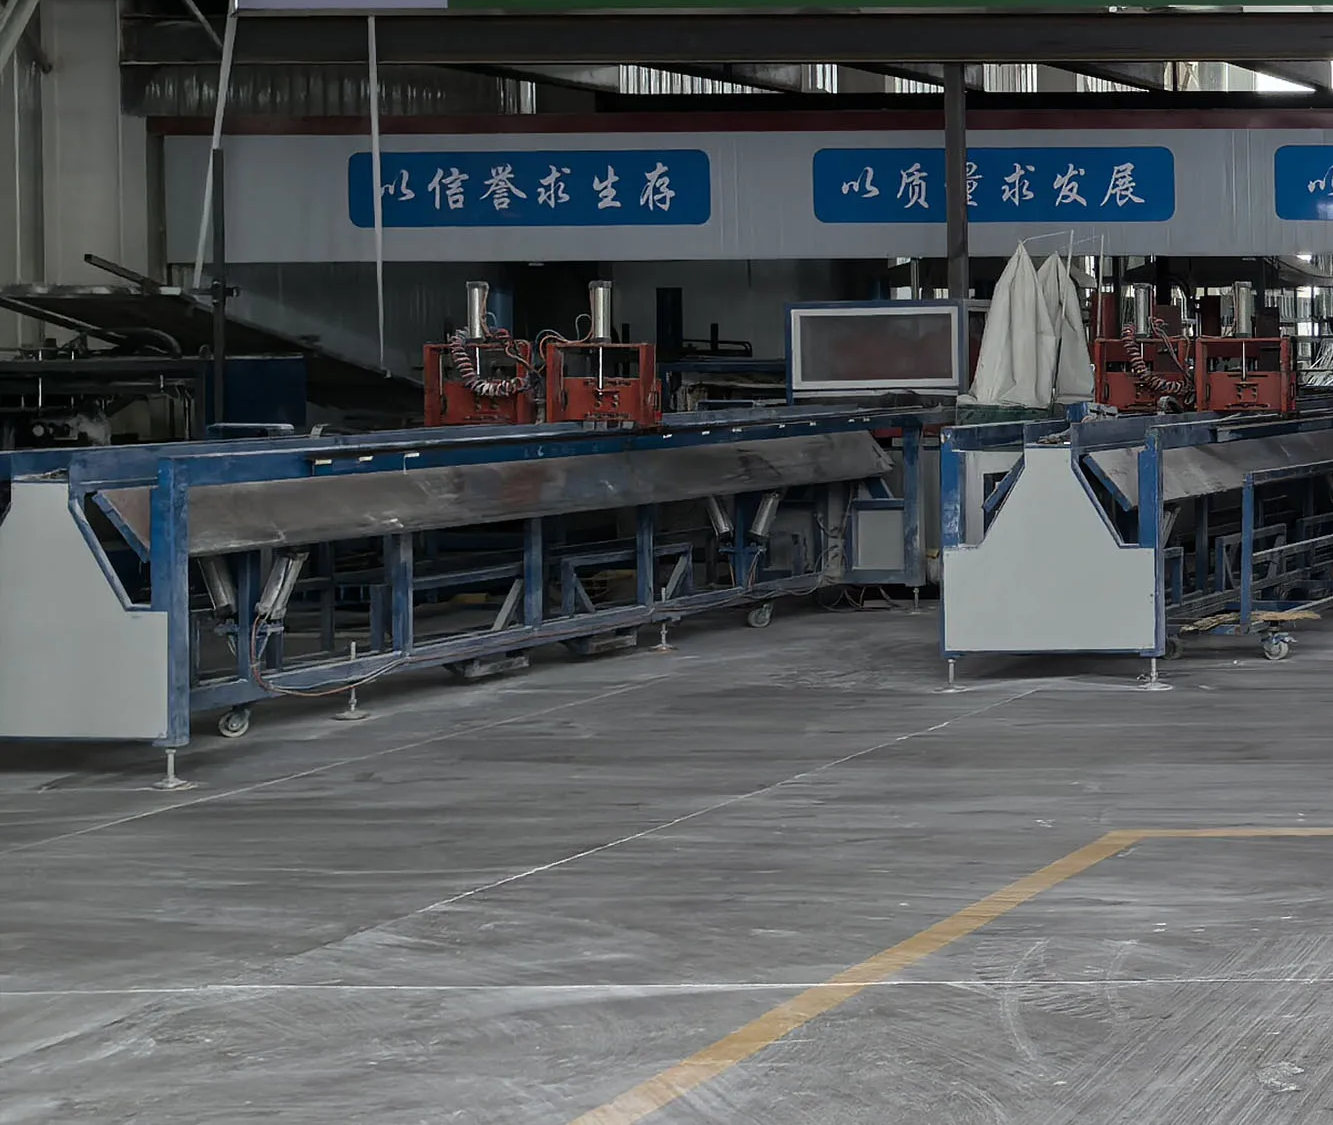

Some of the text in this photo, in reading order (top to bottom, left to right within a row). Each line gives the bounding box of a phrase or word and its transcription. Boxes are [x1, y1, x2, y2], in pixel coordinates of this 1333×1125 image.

[380, 162, 678, 212] 以信誉求生存
